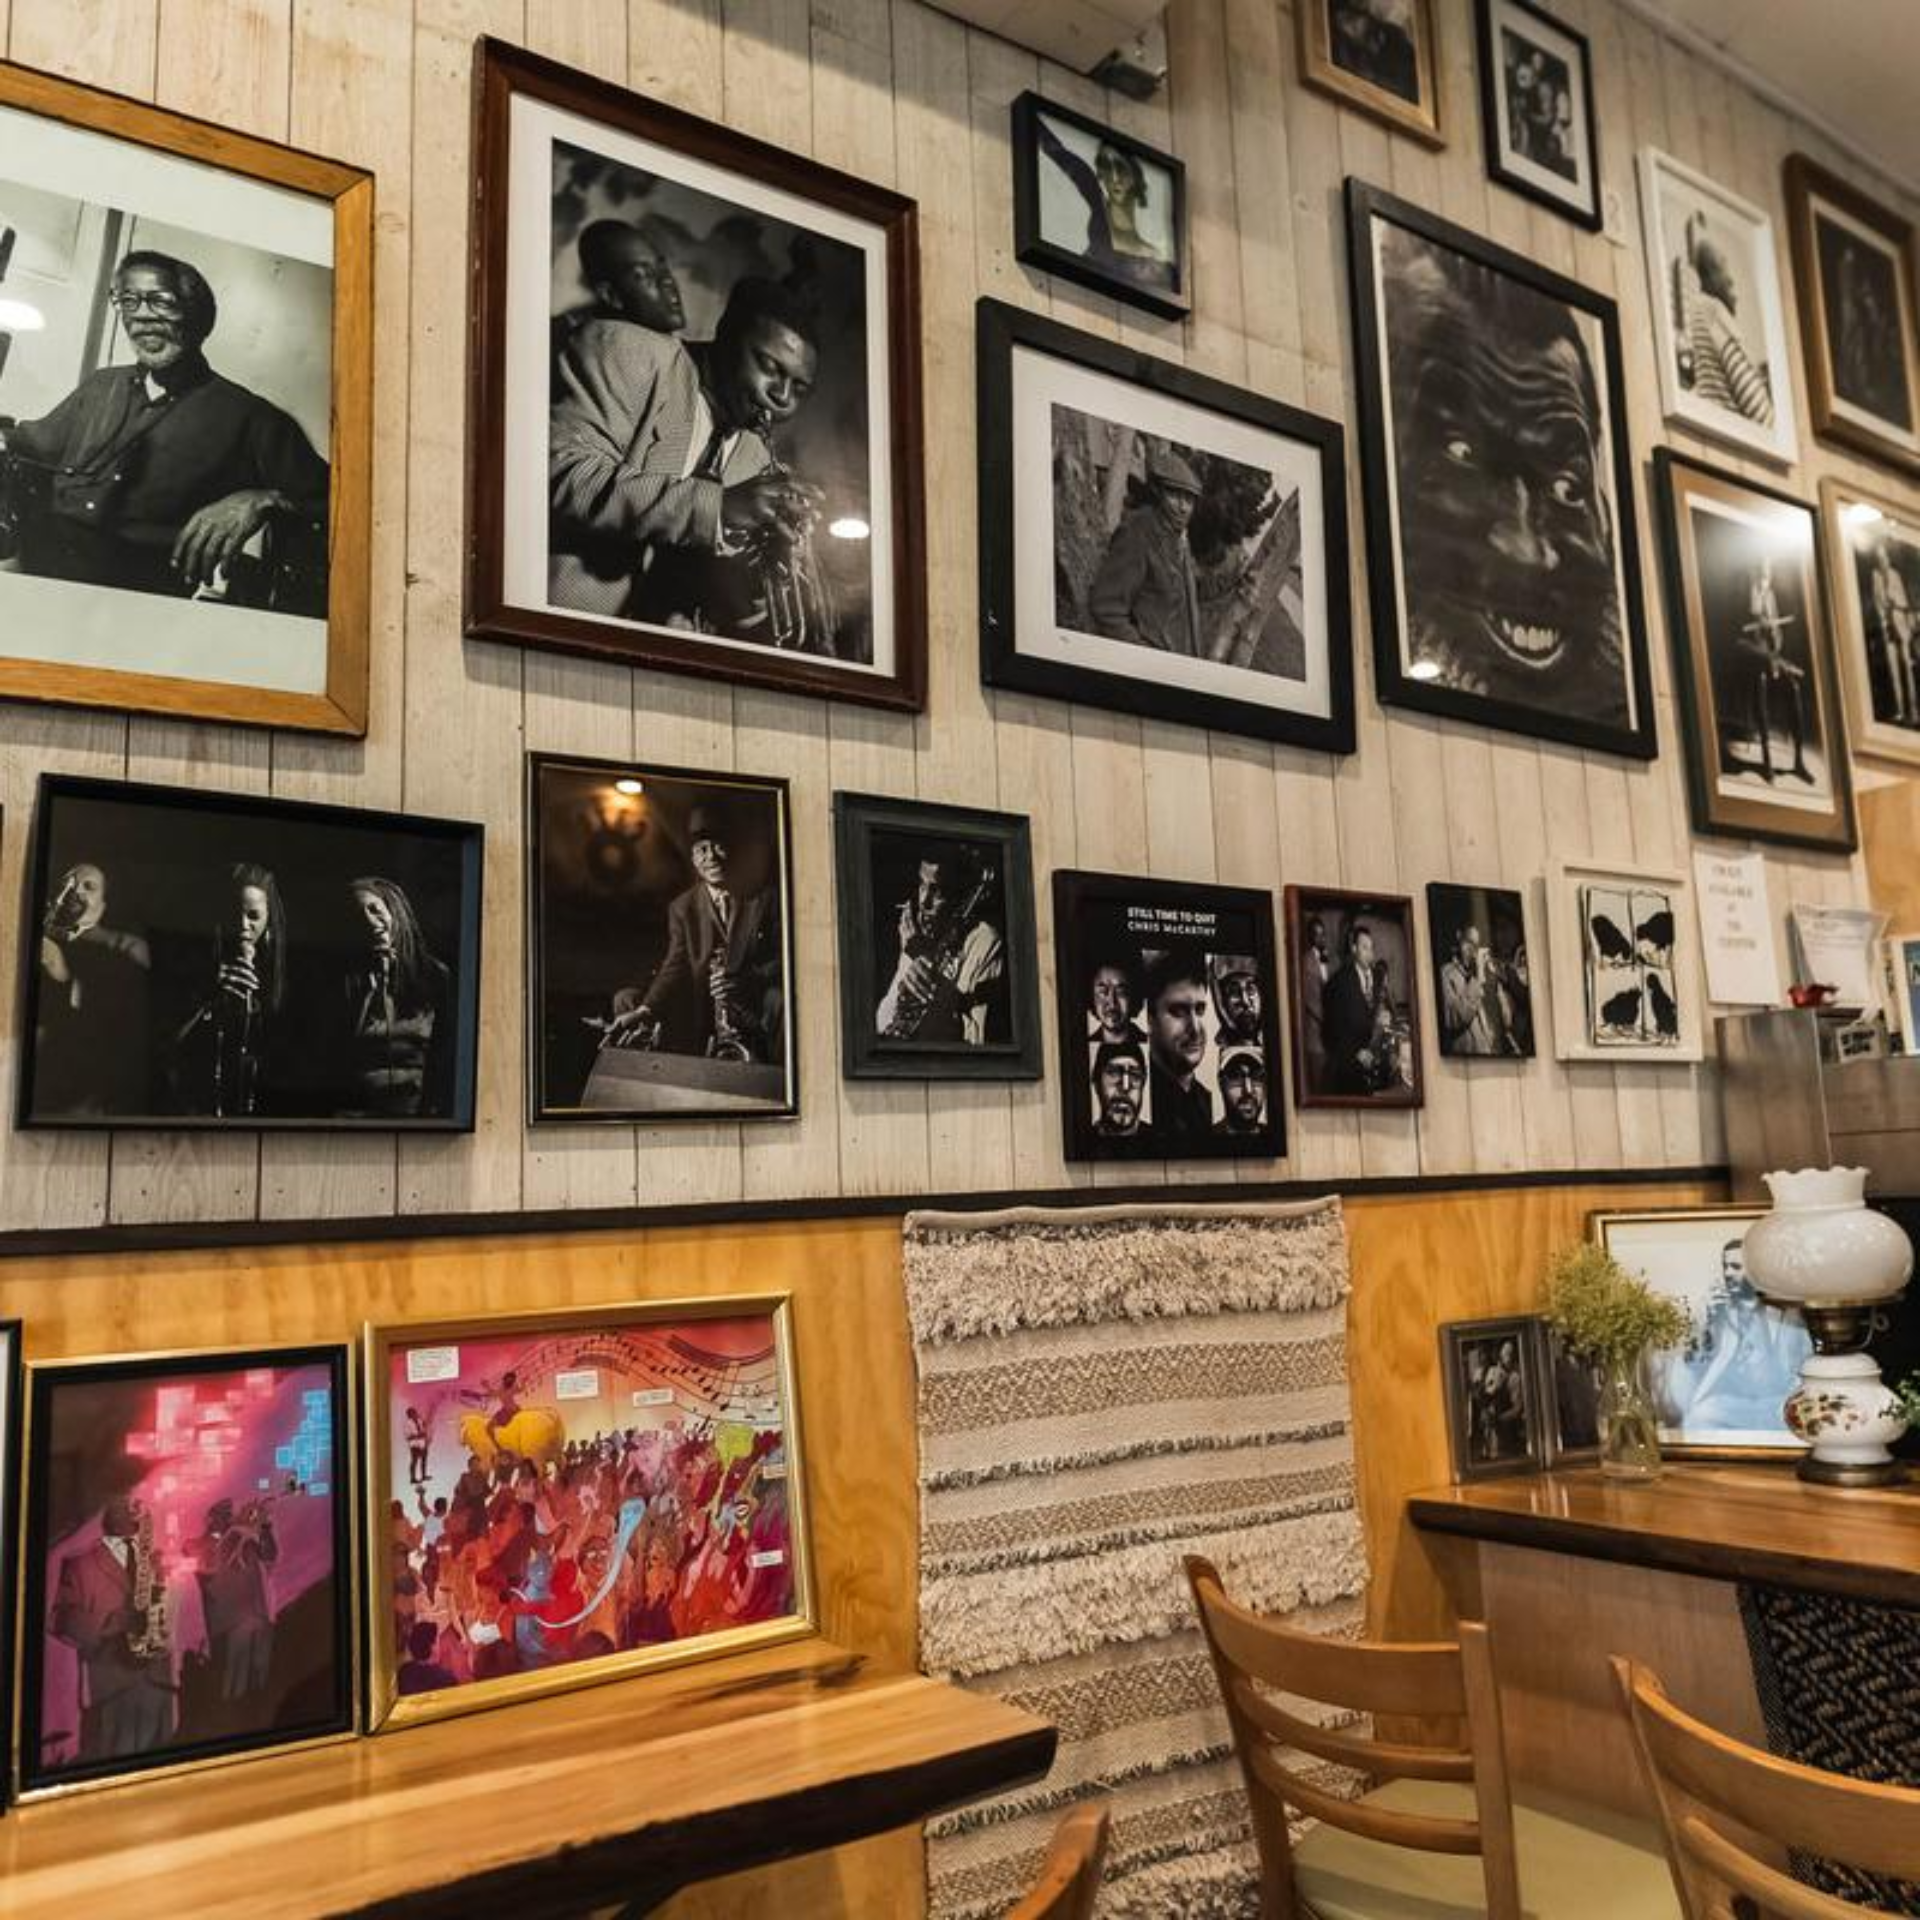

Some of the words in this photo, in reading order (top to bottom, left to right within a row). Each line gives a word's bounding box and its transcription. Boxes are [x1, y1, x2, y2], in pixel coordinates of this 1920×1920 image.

[1127, 907, 1155, 919] STILL
[1155, 909, 1178, 921] TIME
[1180, 911, 1192, 922] TO
[1194, 912, 1216, 924] QUIT
[1127, 921, 1160, 932] CHRIS
